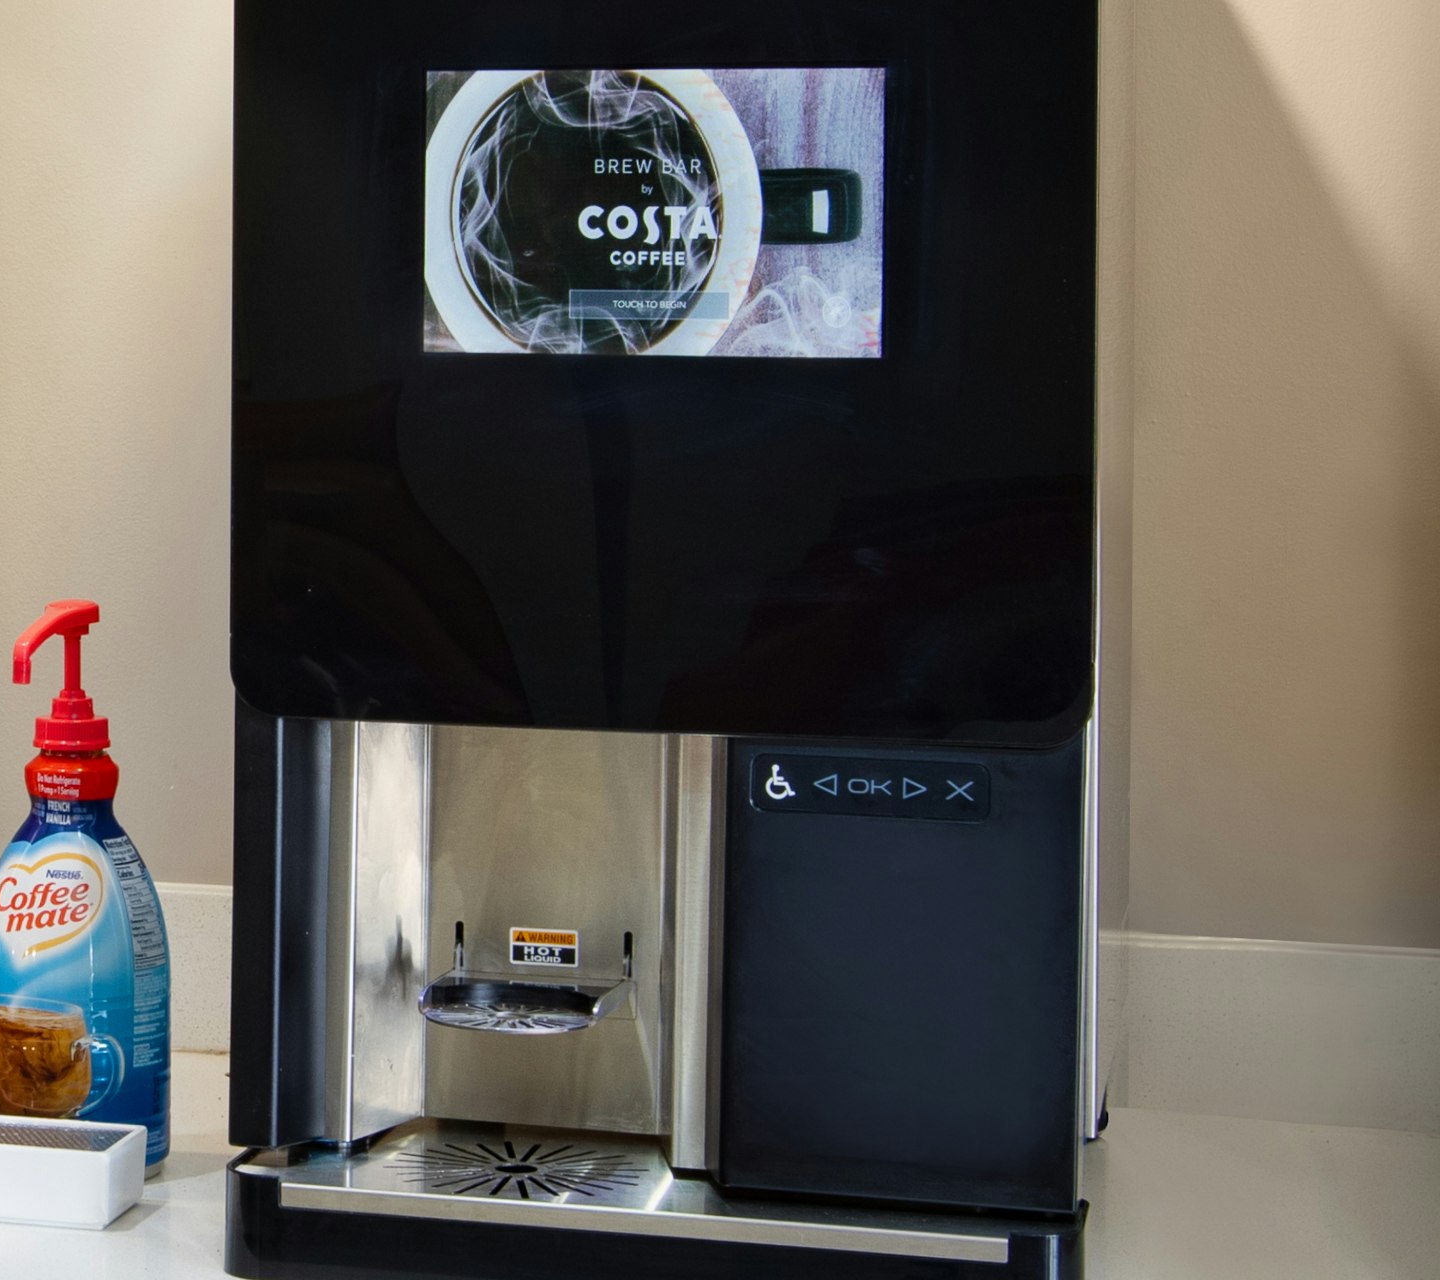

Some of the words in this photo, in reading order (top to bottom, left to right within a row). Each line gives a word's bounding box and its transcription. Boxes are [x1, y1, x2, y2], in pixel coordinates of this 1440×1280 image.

[594, 158, 652, 174] BREW
[662, 158, 702, 174] BAR
[641, 184, 653, 195] by
[578, 205, 717, 245] COSTA
[610, 251, 686, 266] COFFEE
[612, 300, 643, 309] TOUCH
[645, 300, 658, 309] TO
[660, 300, 686, 309] BEGIN
[53, 775, 81, 787] Refrigerate
[847, 778, 891, 795] OK
[40, 784, 53, 795] Pump
[61, 787, 80, 798] Serving
[47, 800, 71, 812] FRENCH
[45, 812, 71, 825] VANILLA
[6, 903, 90, 933] mate
[529, 932, 573, 945] WARNING
[524, 946, 562, 956] HOT
[524, 955, 562, 963] LIQUID
